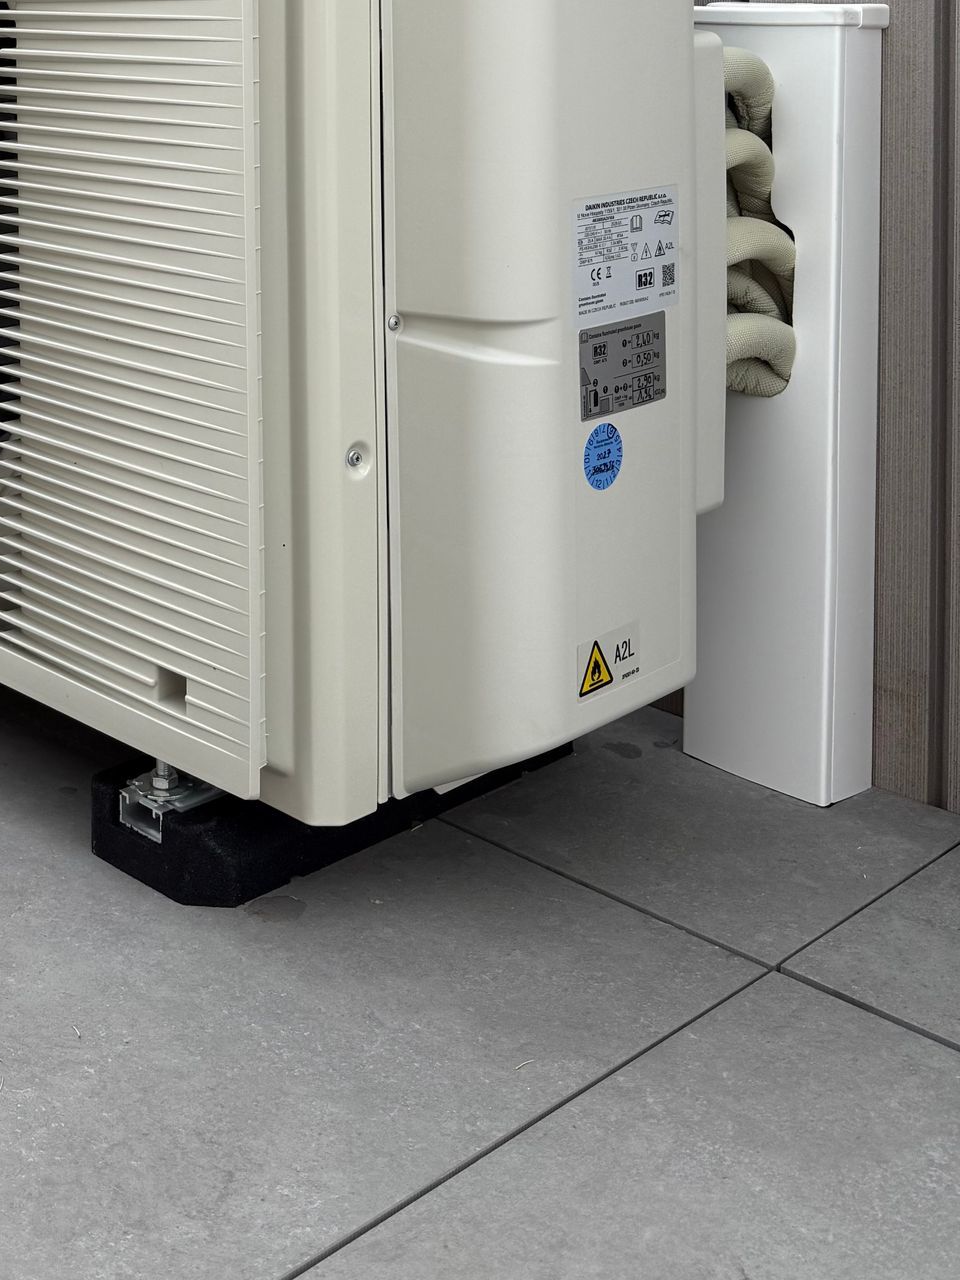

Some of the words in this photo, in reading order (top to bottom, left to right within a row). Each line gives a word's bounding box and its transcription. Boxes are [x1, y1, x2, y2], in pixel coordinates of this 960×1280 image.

[585, 202, 600, 211] DAIKIN
[601, 199, 625, 209] INDUSTRIES
[625, 197, 639, 205] CZECH
[639, 193, 658, 202] REPUBLIC
[637, 271, 653, 288] R32
[593, 343, 607, 358] R32
[636, 352, 652, 367] 0,50
[614, 638, 635, 665] A2L
